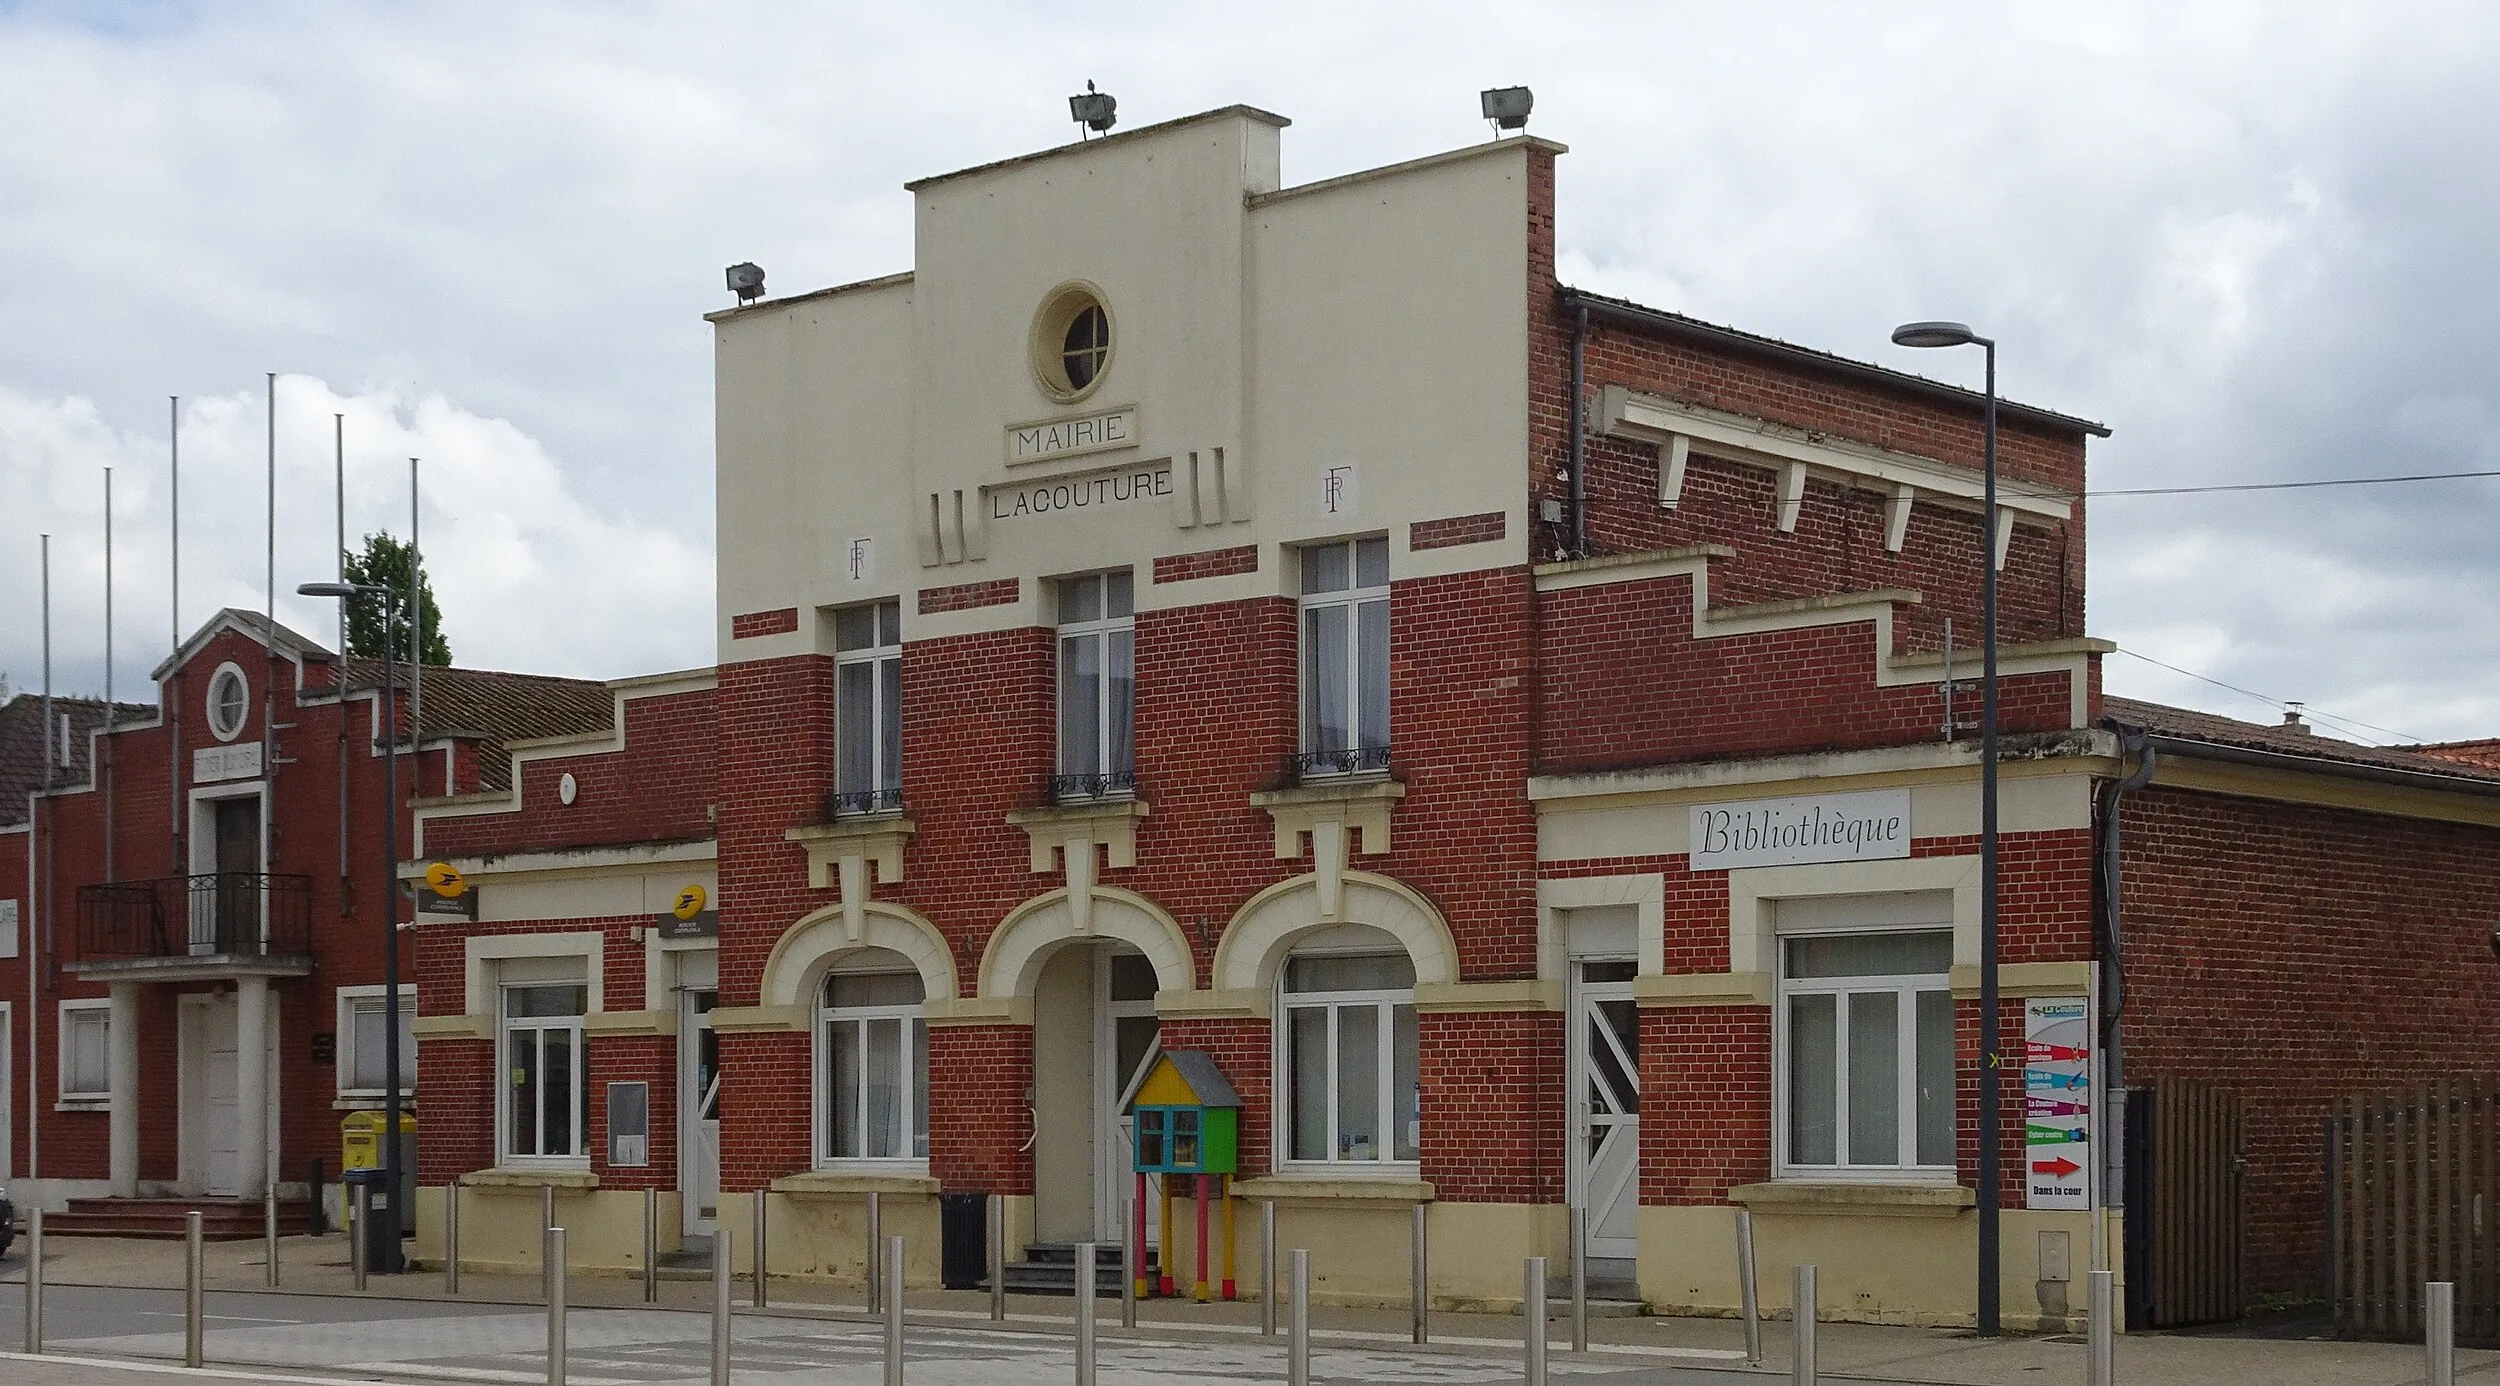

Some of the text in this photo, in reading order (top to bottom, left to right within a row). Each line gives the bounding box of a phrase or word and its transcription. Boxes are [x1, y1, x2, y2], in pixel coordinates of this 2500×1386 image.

[1018, 415, 1126, 455] MAIRIE
[1699, 806, 1899, 854] Bibliothèque
[2033, 1186, 2082, 1195] Dans la cour
